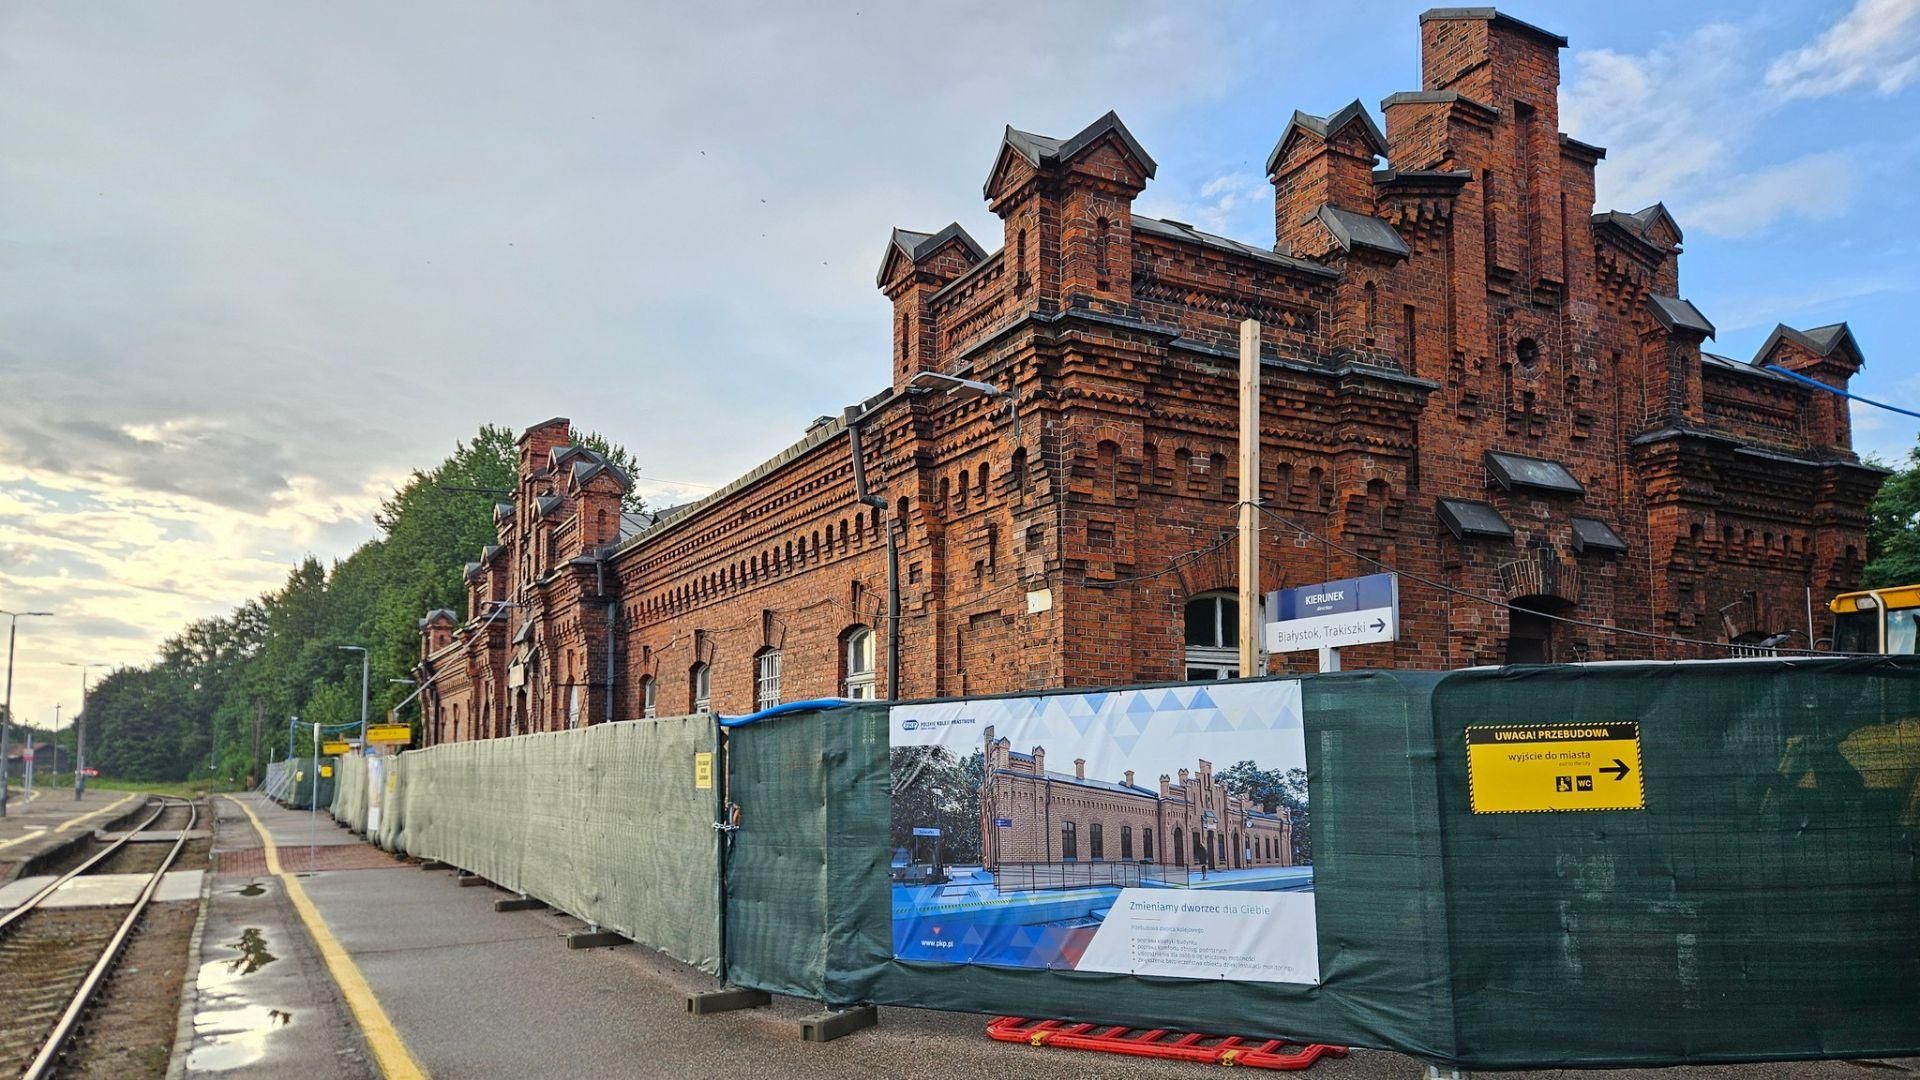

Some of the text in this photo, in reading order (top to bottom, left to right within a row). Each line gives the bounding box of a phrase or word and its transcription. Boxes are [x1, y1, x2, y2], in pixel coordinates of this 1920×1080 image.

[1305, 591, 1344, 604] KIERUNEK
[1278, 622, 1366, 642] Białystok, Trakiszki
[1494, 729, 1609, 741] UWAGA! PRZEBUDOWA
[1508, 750, 1591, 763] wyjście do miasta
[1577, 779, 1592, 787] WC
[1129, 901, 1271, 915] Zmieniamy dworzec dla Ciebie
[920, 940, 953, 948] www.pkp.pl
